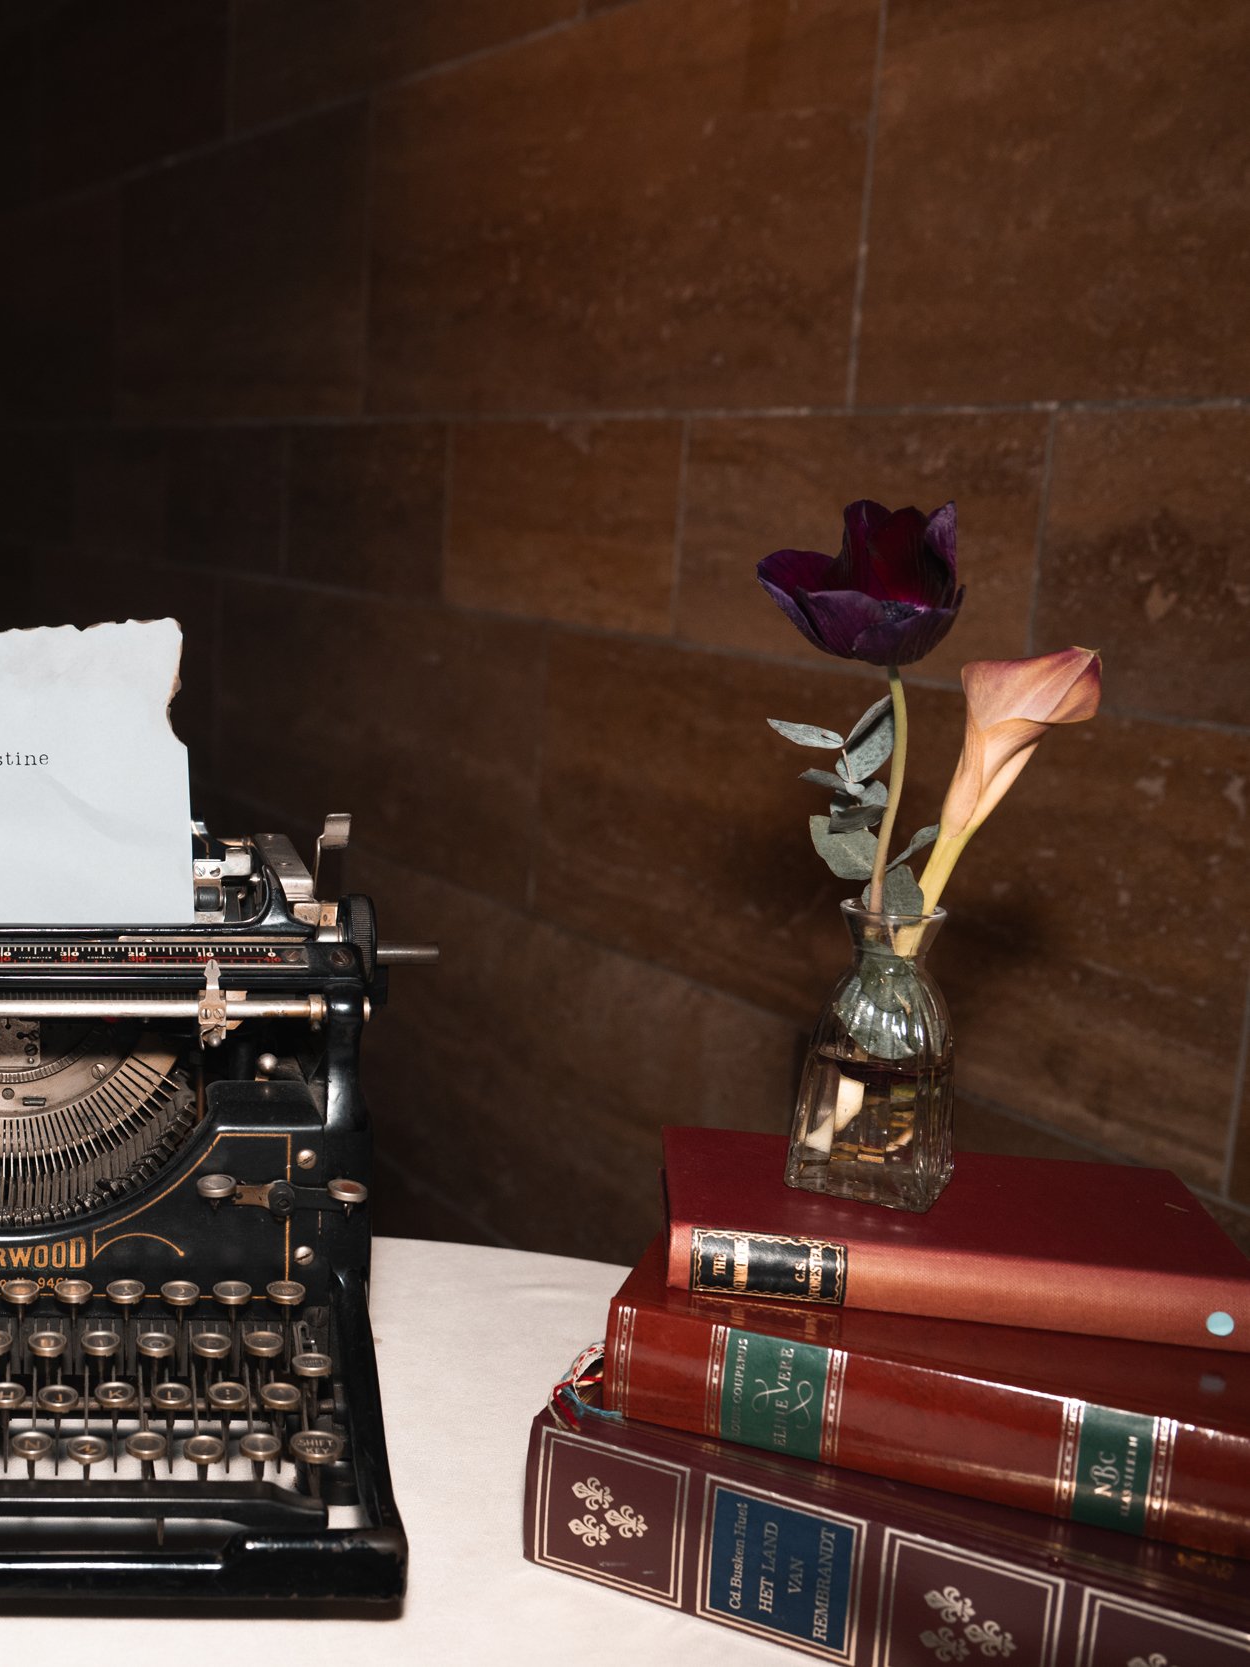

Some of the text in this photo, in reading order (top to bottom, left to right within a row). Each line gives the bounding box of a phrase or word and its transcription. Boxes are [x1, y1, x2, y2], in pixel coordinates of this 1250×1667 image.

[712, 1252, 727, 1276] THE
[794, 1258, 807, 1283] C.S.
[808, 1246, 823, 1297] FORESTER
[297, 1439, 334, 1447] SHIFT
[304, 1447, 330, 1455] KEY
[734, 1502, 749, 1538] Huet
[730, 1540, 746, 1589] Busken
[758, 1521, 779, 1614] HET LAND
[788, 1556, 804, 1595] VAN
[812, 1527, 836, 1642] REMBRANDT
